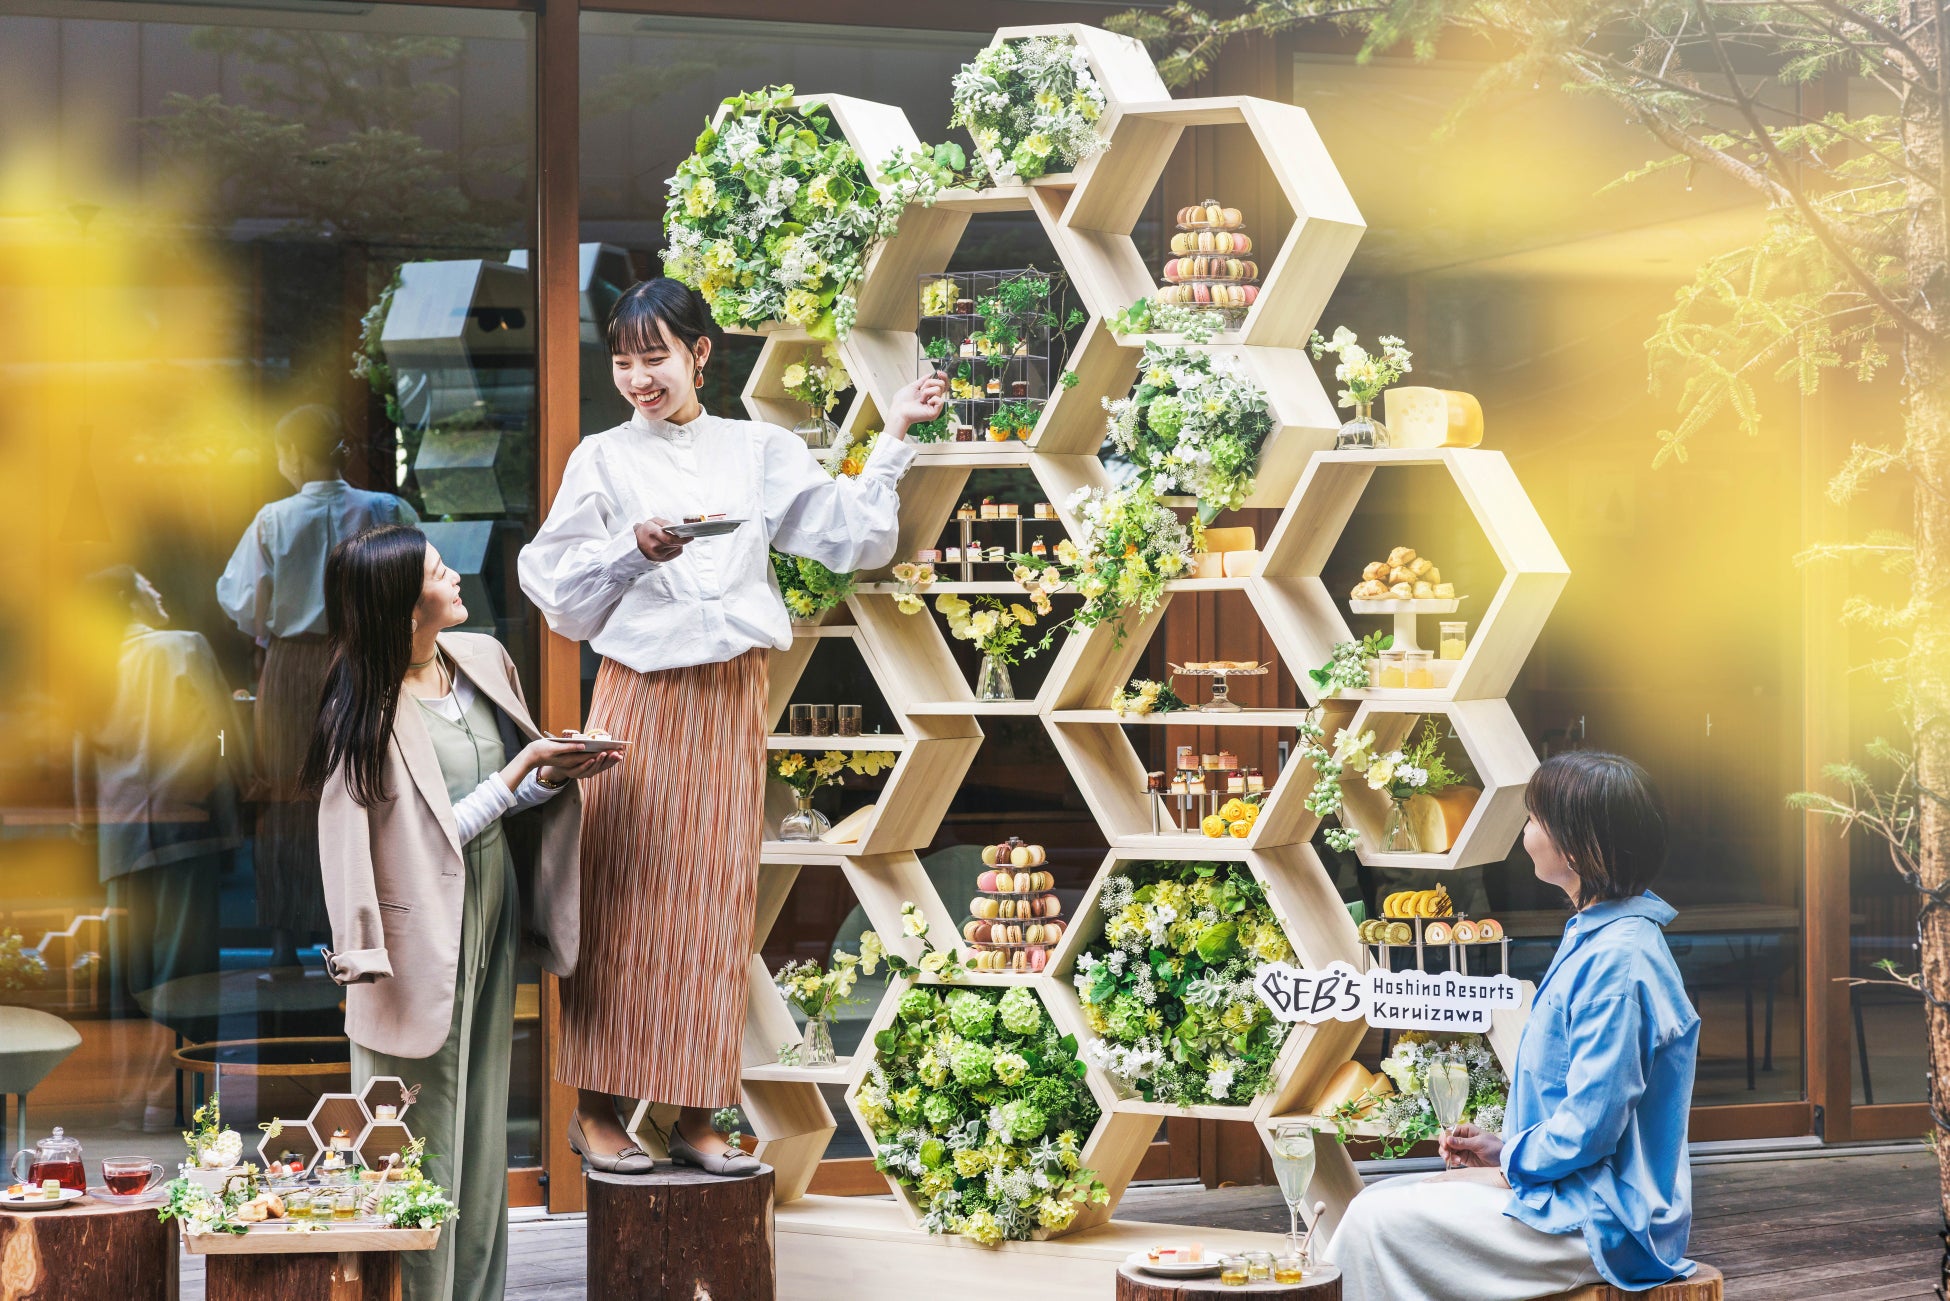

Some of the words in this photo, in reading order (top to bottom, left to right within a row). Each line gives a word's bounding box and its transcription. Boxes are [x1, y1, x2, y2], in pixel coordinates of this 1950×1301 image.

[1373, 977, 1441, 997] Hoshino
[1446, 980, 1514, 1000] Resorts
[1373, 1001, 1483, 1023] Karuizawa
